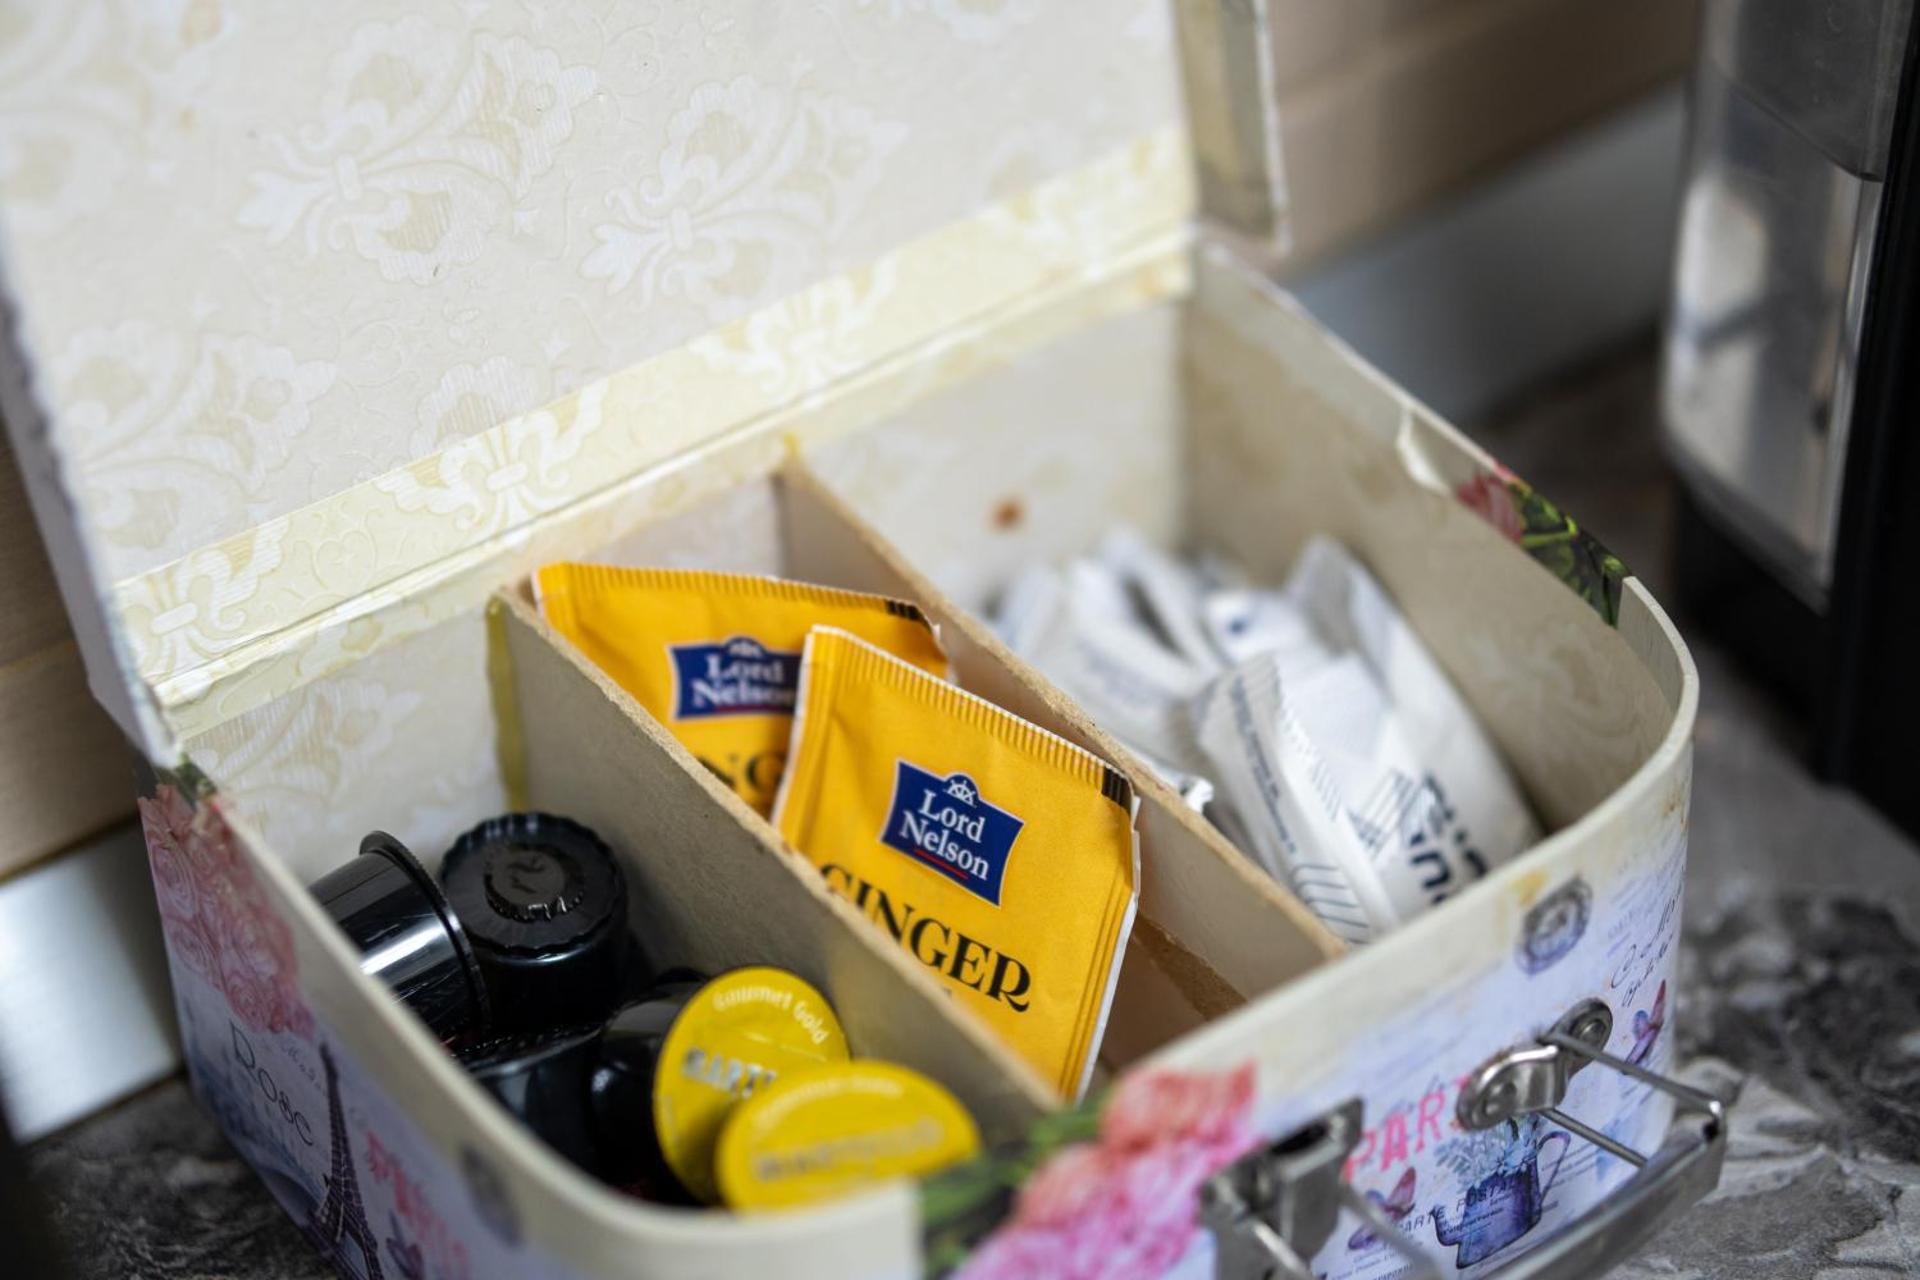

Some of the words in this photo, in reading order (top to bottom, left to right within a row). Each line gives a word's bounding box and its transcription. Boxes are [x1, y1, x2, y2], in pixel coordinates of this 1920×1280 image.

[706, 653, 784, 683] Lord
[899, 810, 989, 880] Nelson
[918, 789, 986, 843] Lord
[1342, 1075, 1471, 1183] PAR
